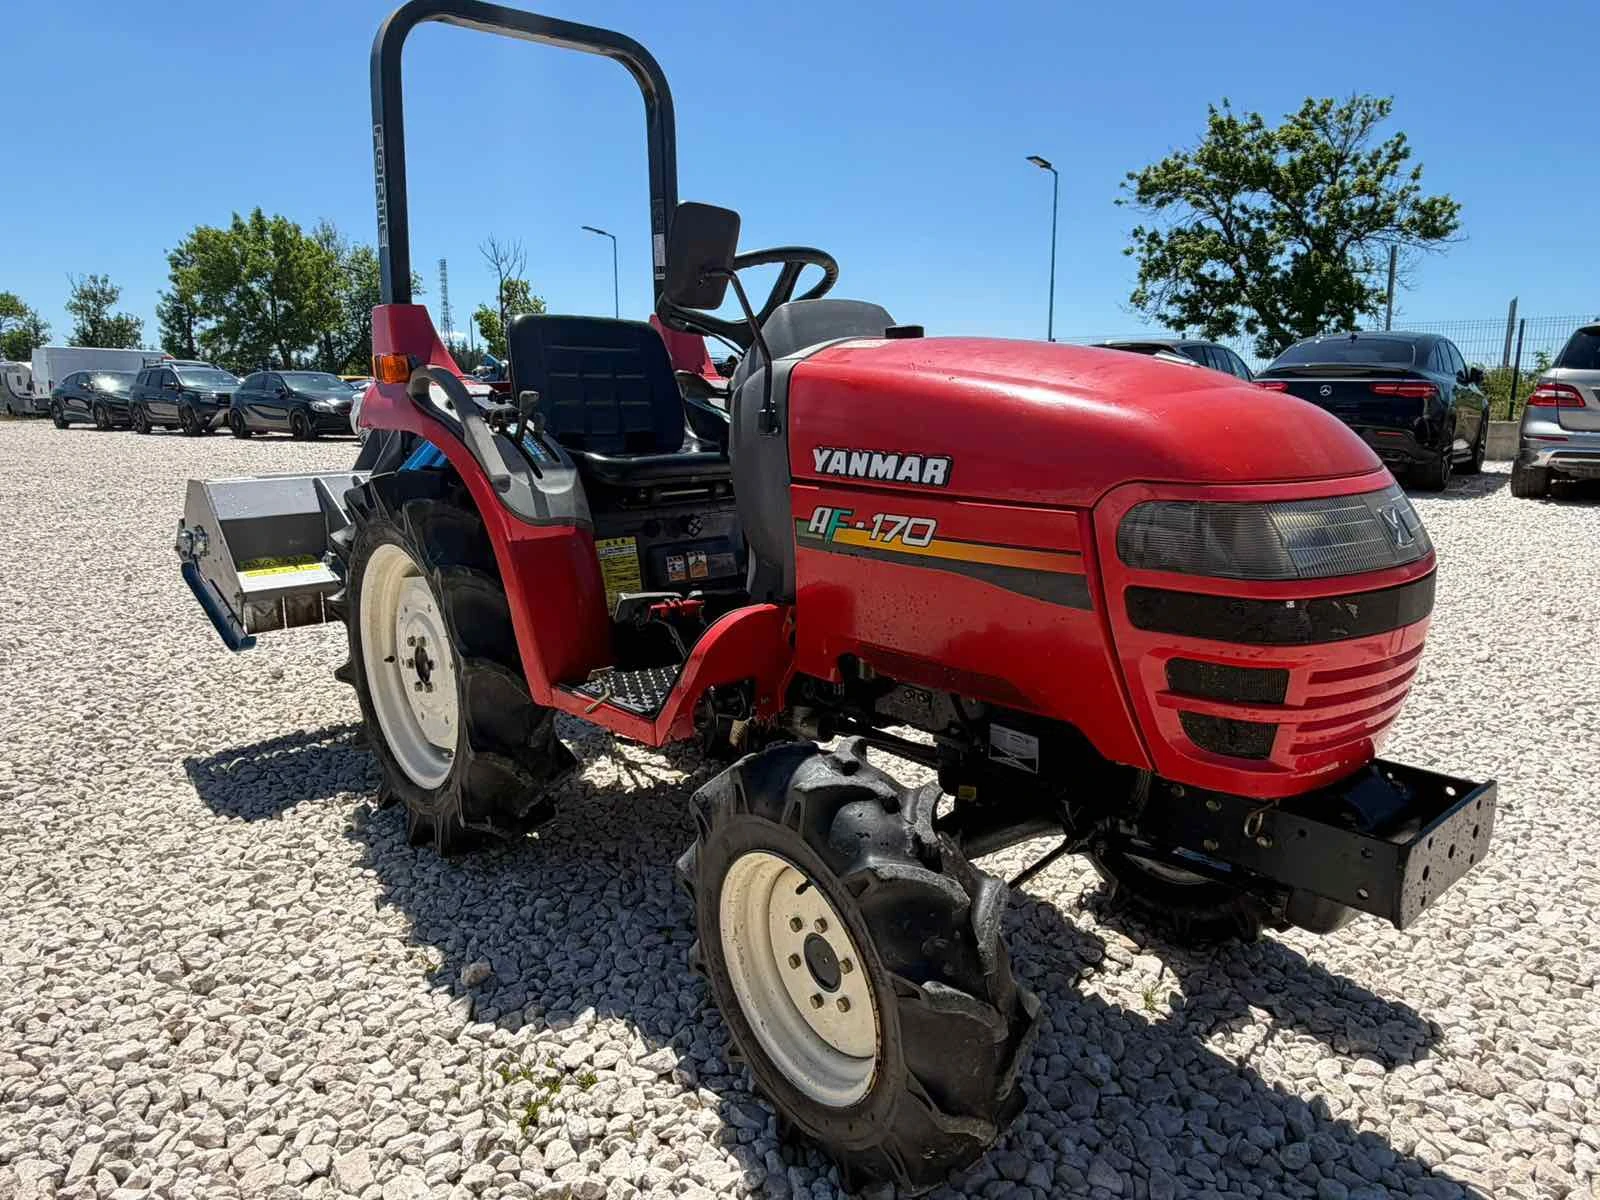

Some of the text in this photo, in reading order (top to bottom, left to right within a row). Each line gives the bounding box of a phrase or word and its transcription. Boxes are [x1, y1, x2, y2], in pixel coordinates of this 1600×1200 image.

[373, 123, 389, 248] FORTE
[812, 447, 951, 486] YANMAR
[807, 506, 938, 548] AF-170
